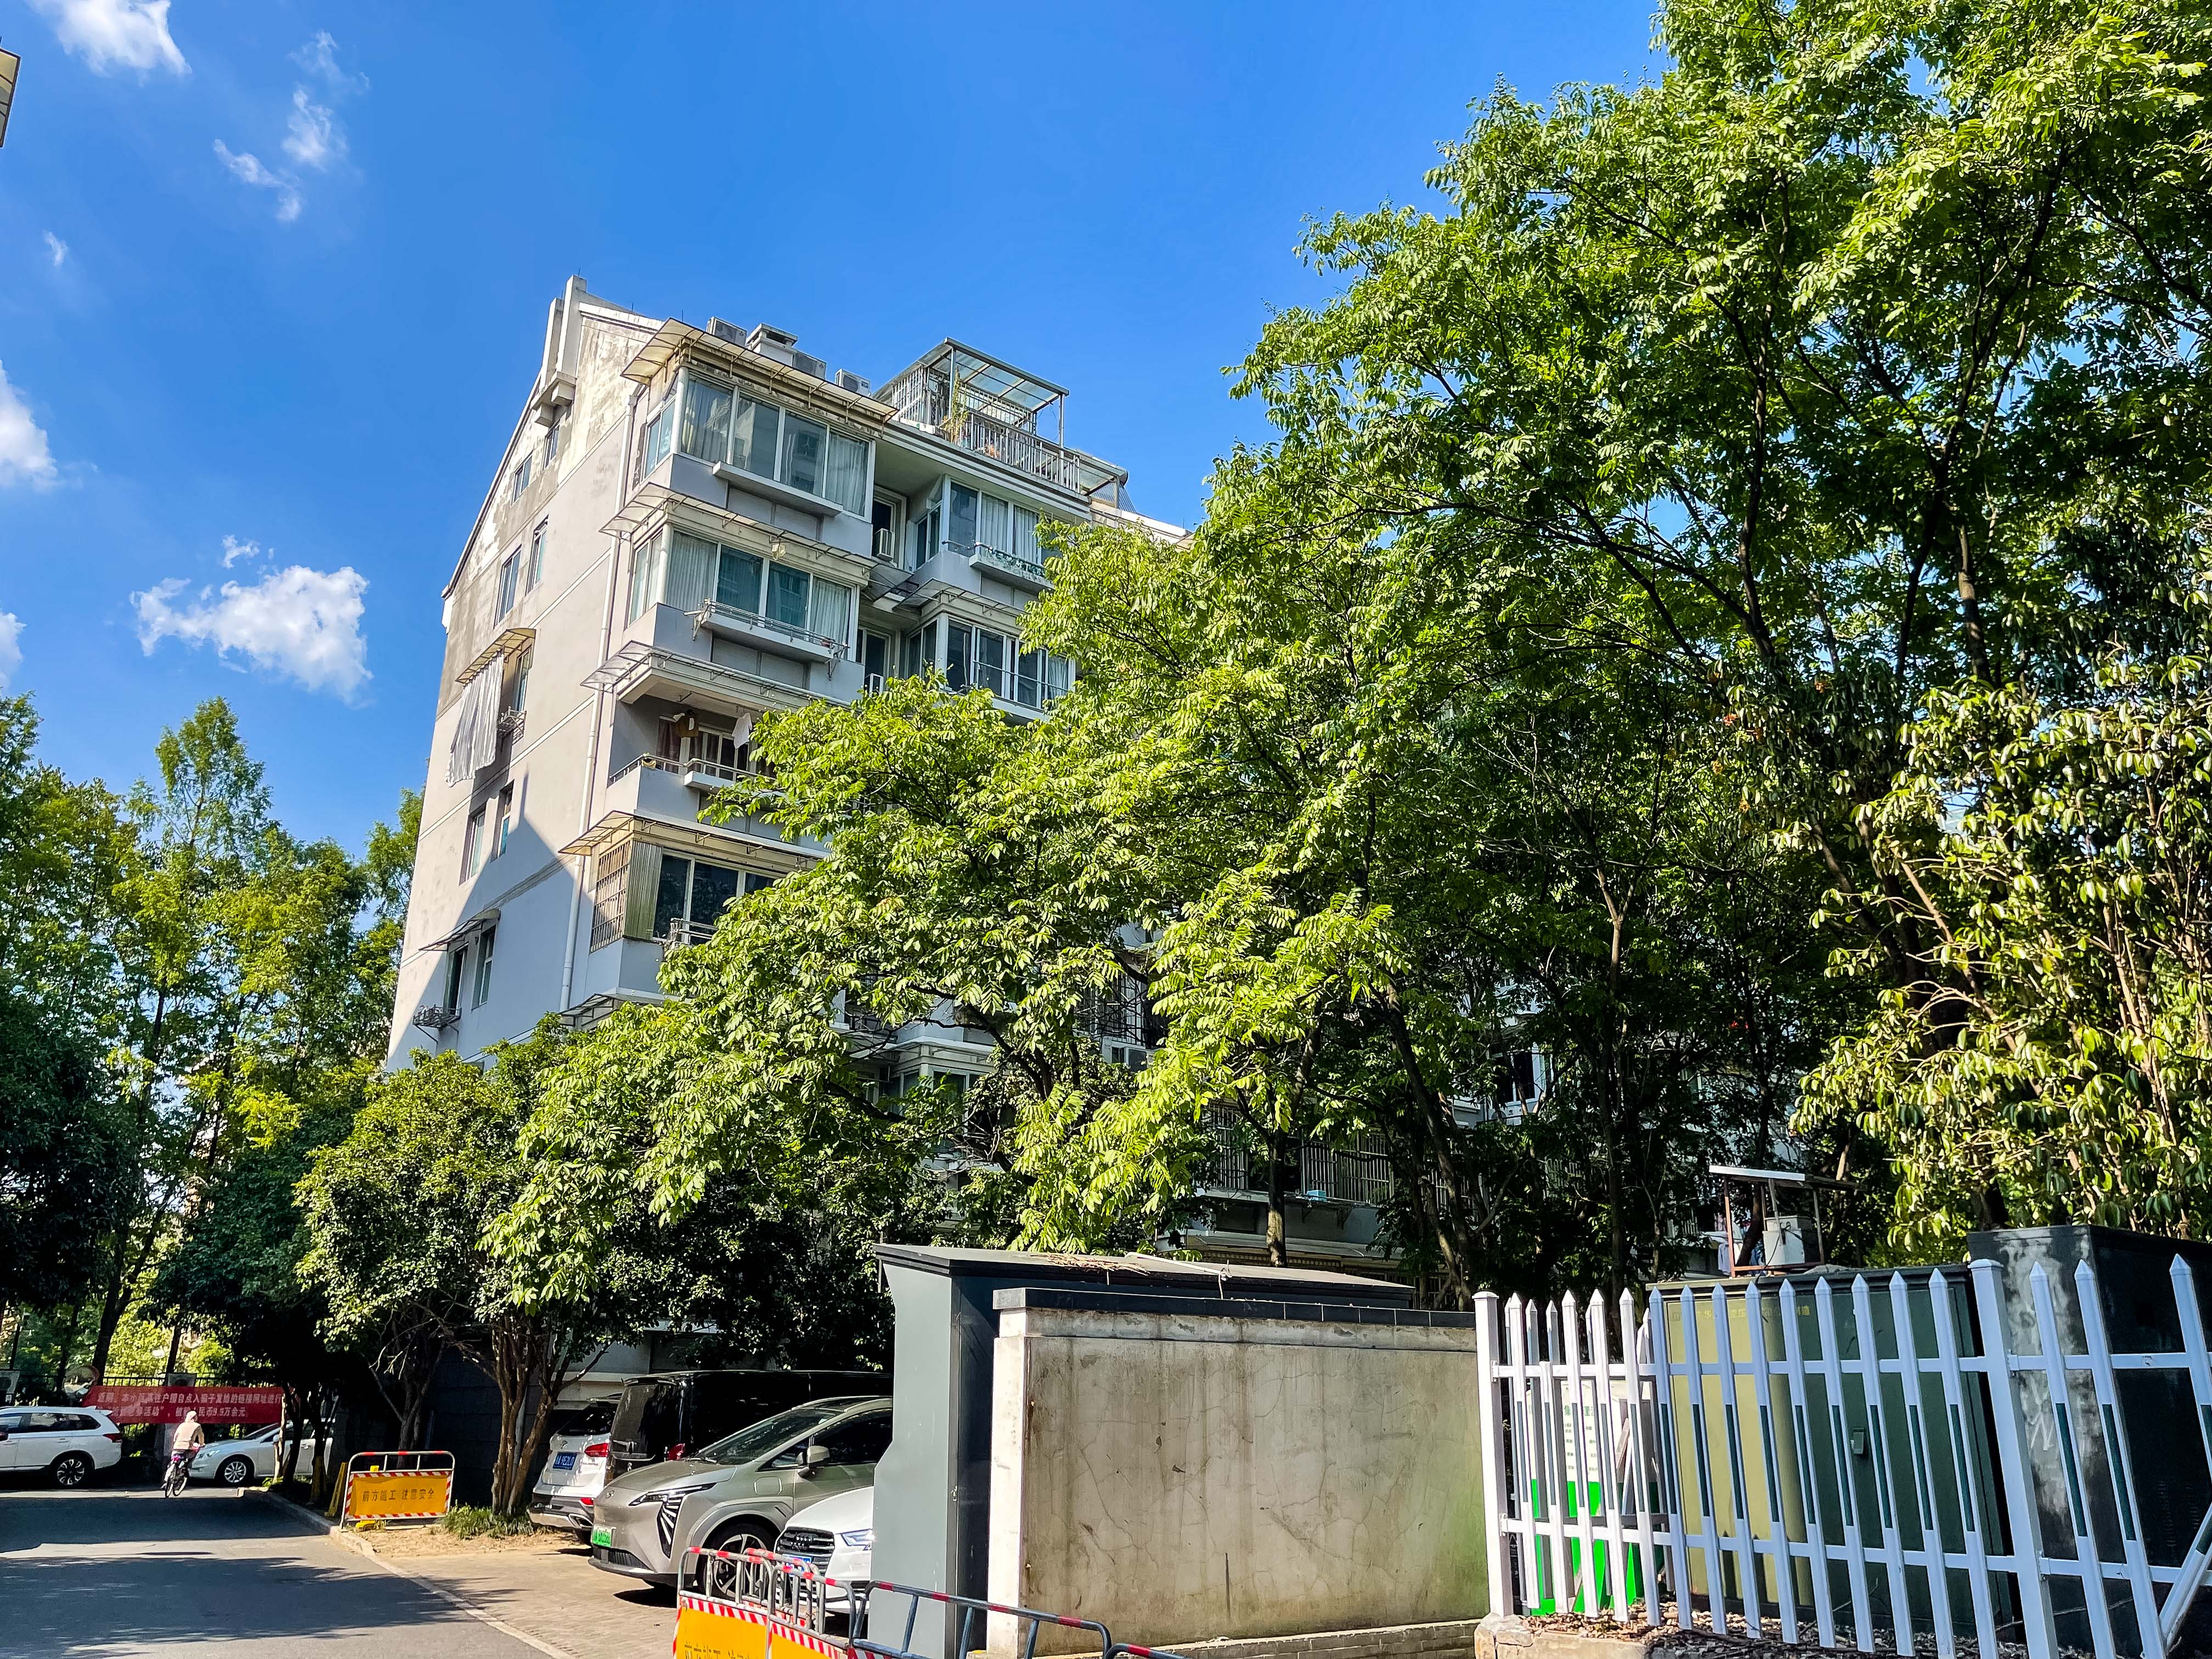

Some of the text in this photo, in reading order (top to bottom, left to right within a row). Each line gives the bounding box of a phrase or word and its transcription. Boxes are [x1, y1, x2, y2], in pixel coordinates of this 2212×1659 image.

[362, 1487, 435, 1502] 前方施工 注意安全
